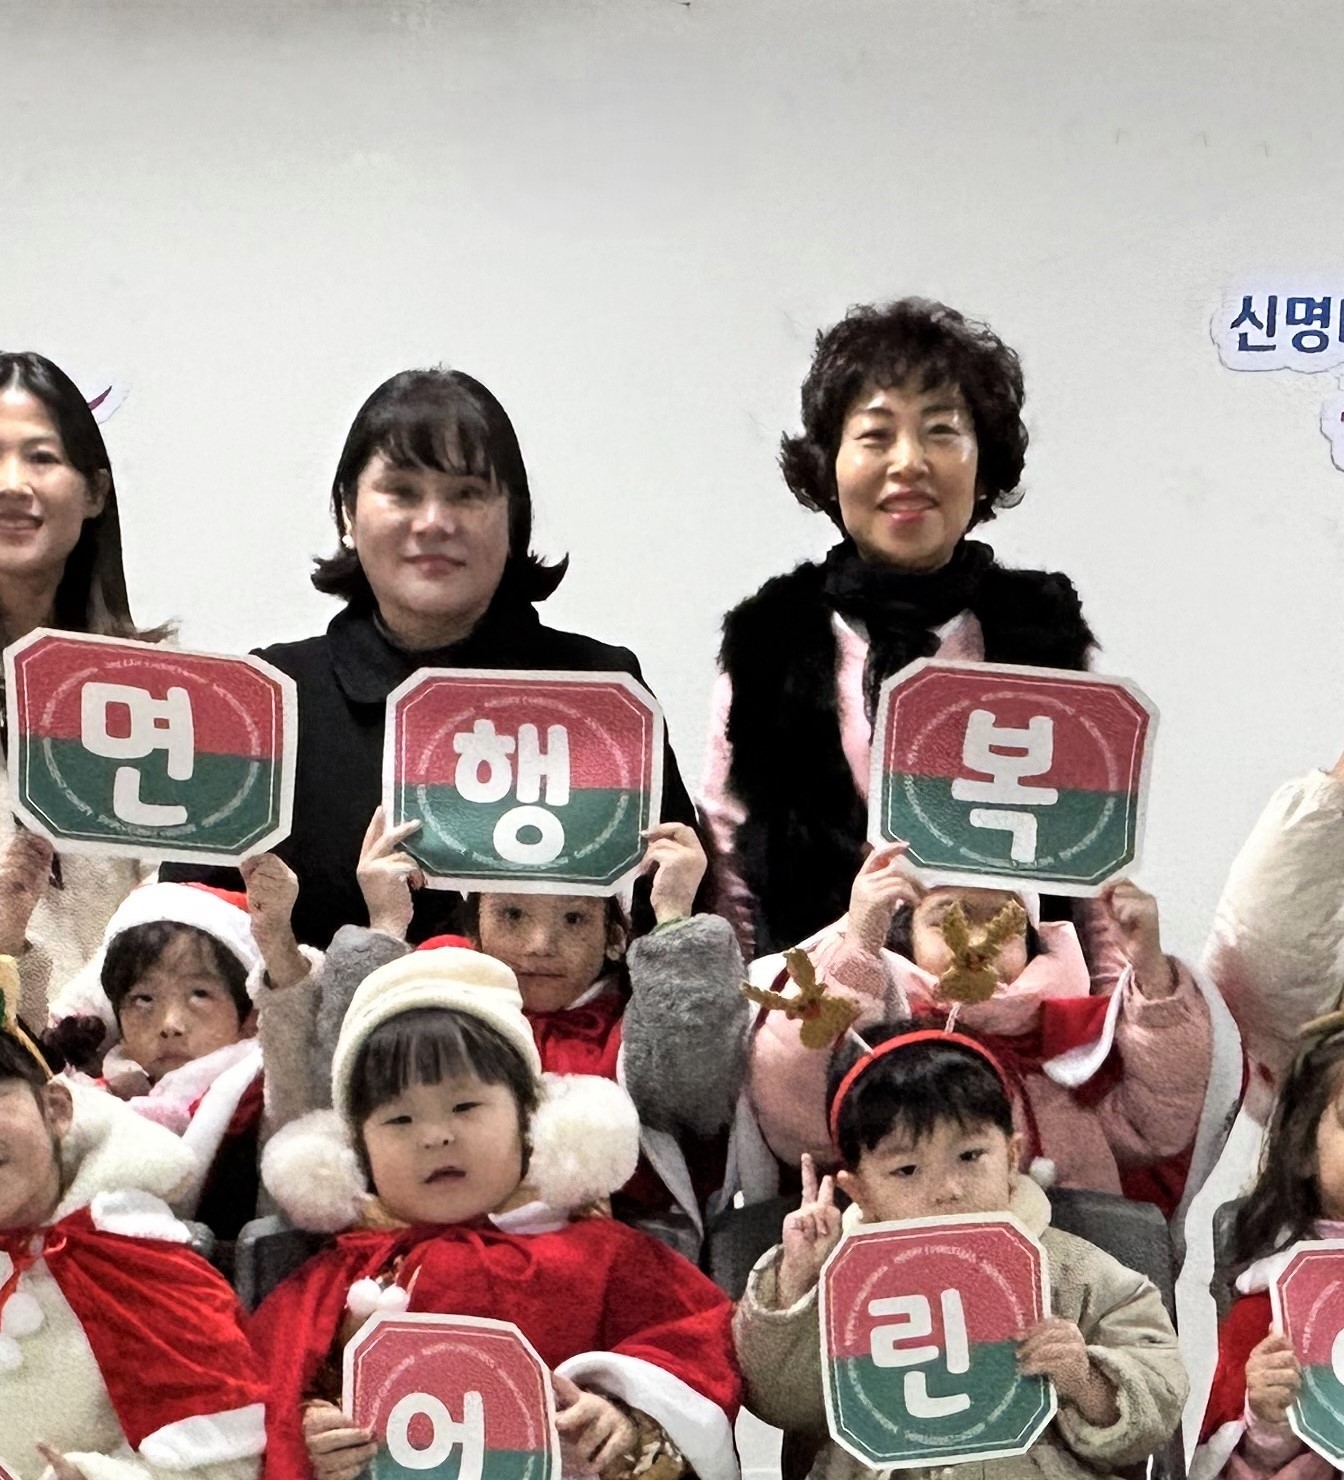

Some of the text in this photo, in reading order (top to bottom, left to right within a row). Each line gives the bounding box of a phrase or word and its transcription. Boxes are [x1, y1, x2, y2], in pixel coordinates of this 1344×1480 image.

[80, 681, 195, 827] 면
[453, 718, 571, 867] 행
[951, 709, 1059, 863] 복
[867, 1287, 971, 1419] 린
